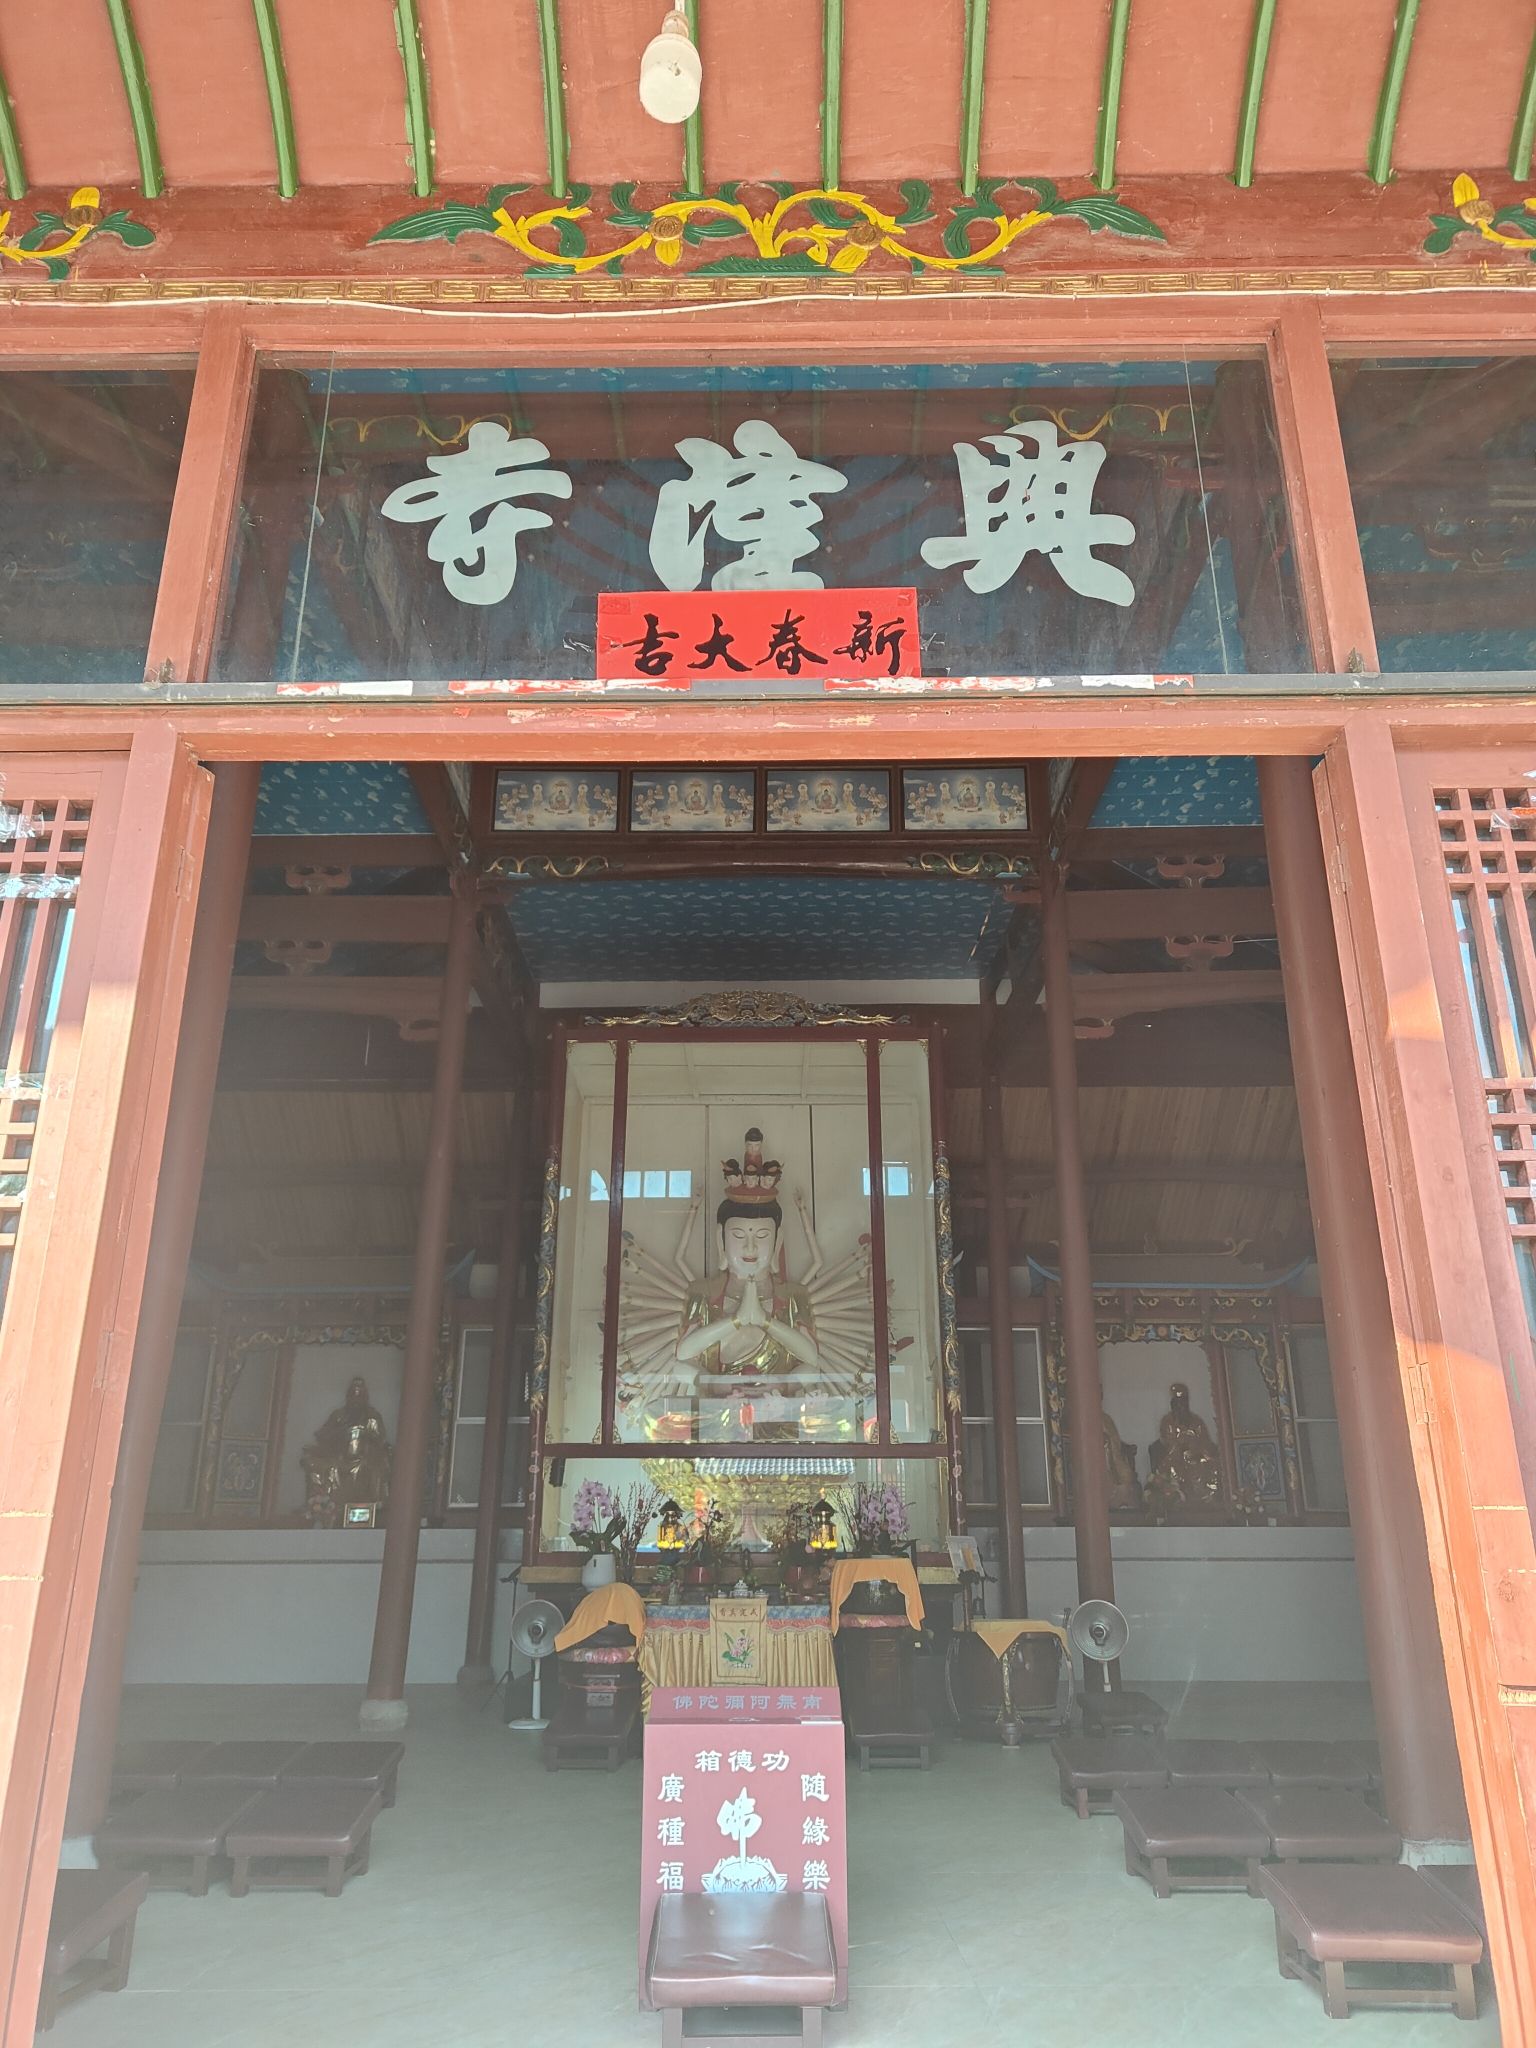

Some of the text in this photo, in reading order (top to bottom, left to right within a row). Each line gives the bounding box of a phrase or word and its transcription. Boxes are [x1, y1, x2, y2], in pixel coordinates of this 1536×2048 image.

[610, 608, 908, 676] 新春大吉
[672, 1694, 823, 1710] 南無阿彌陀佛
[694, 1749, 790, 1773] 功德箱
